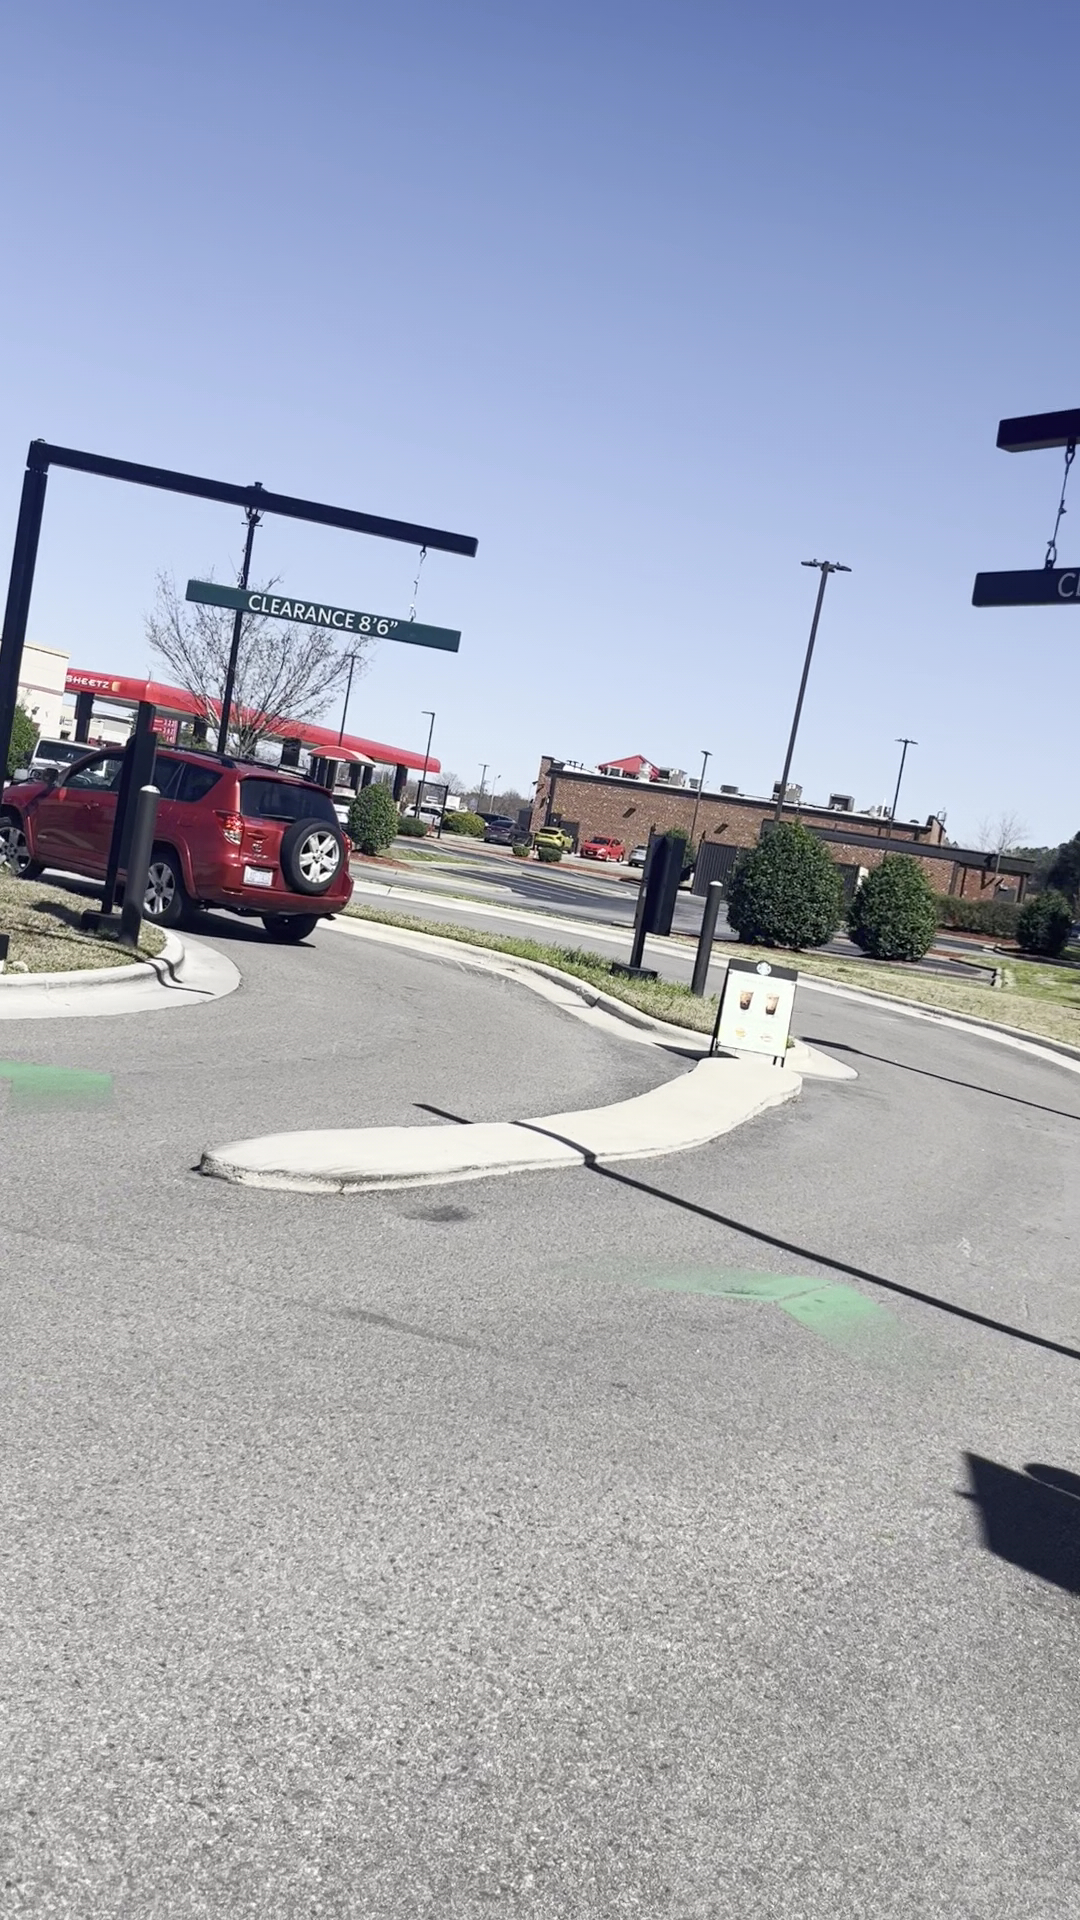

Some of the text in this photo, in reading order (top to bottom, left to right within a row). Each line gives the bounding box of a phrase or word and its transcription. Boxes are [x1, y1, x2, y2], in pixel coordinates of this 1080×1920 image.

[248, 594, 399, 636] CLEARANCE 8'6"
[65, 675, 110, 689] SHEETZ
